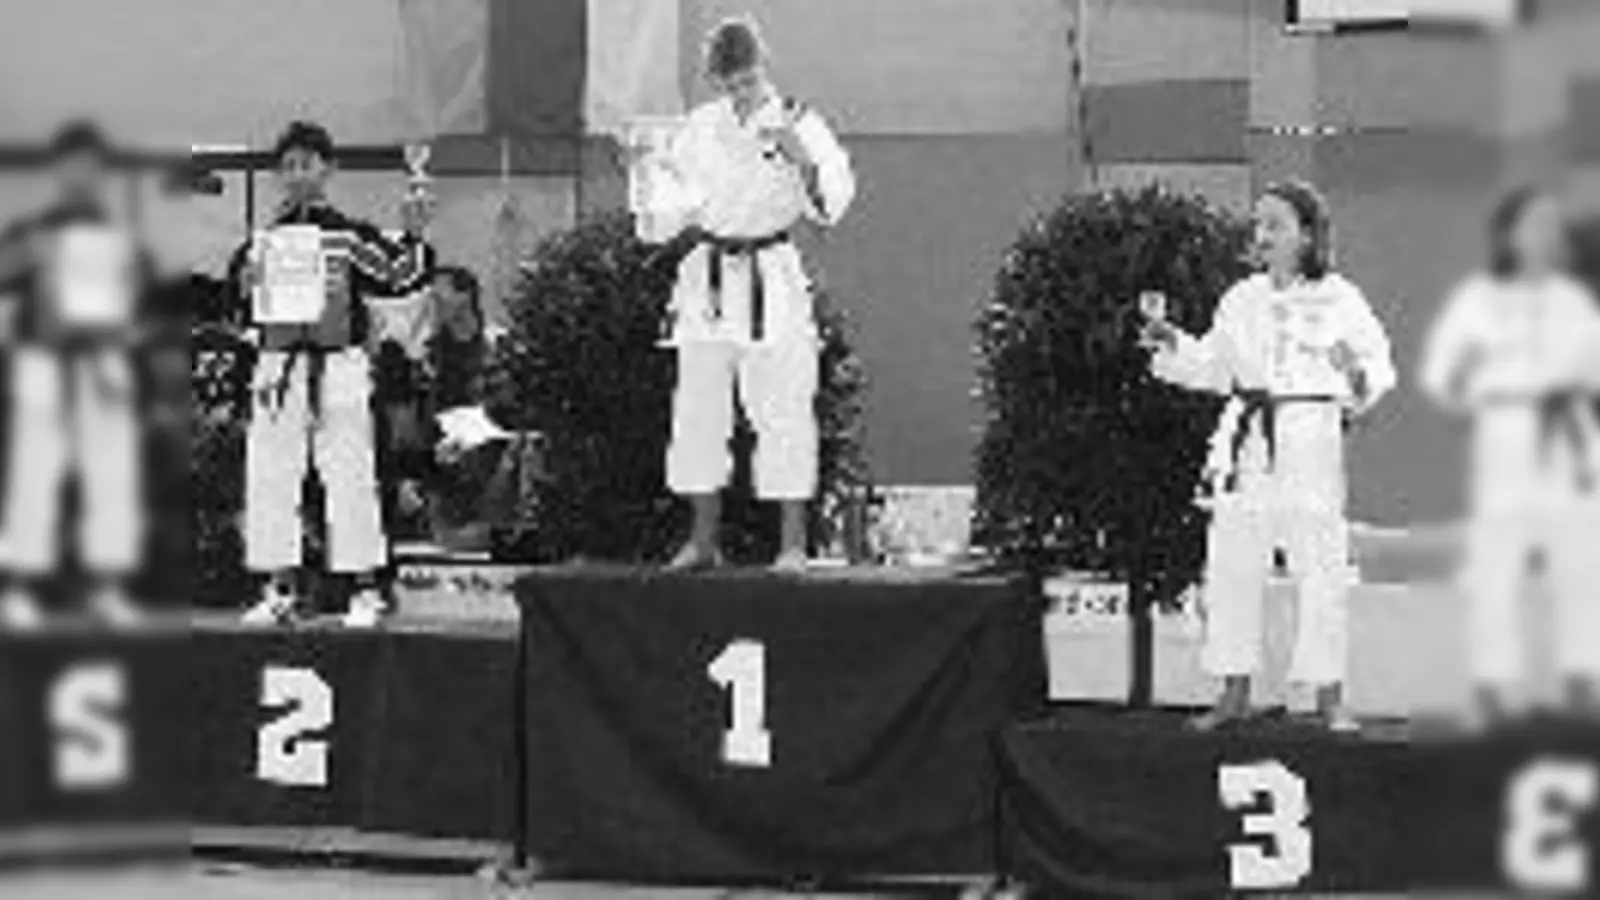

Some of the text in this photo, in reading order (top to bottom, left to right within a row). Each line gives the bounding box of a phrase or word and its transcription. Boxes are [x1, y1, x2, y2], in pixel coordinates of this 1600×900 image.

[256, 665, 335, 788] 2
[707, 639, 772, 768] 1
[1218, 759, 1313, 890] 3
